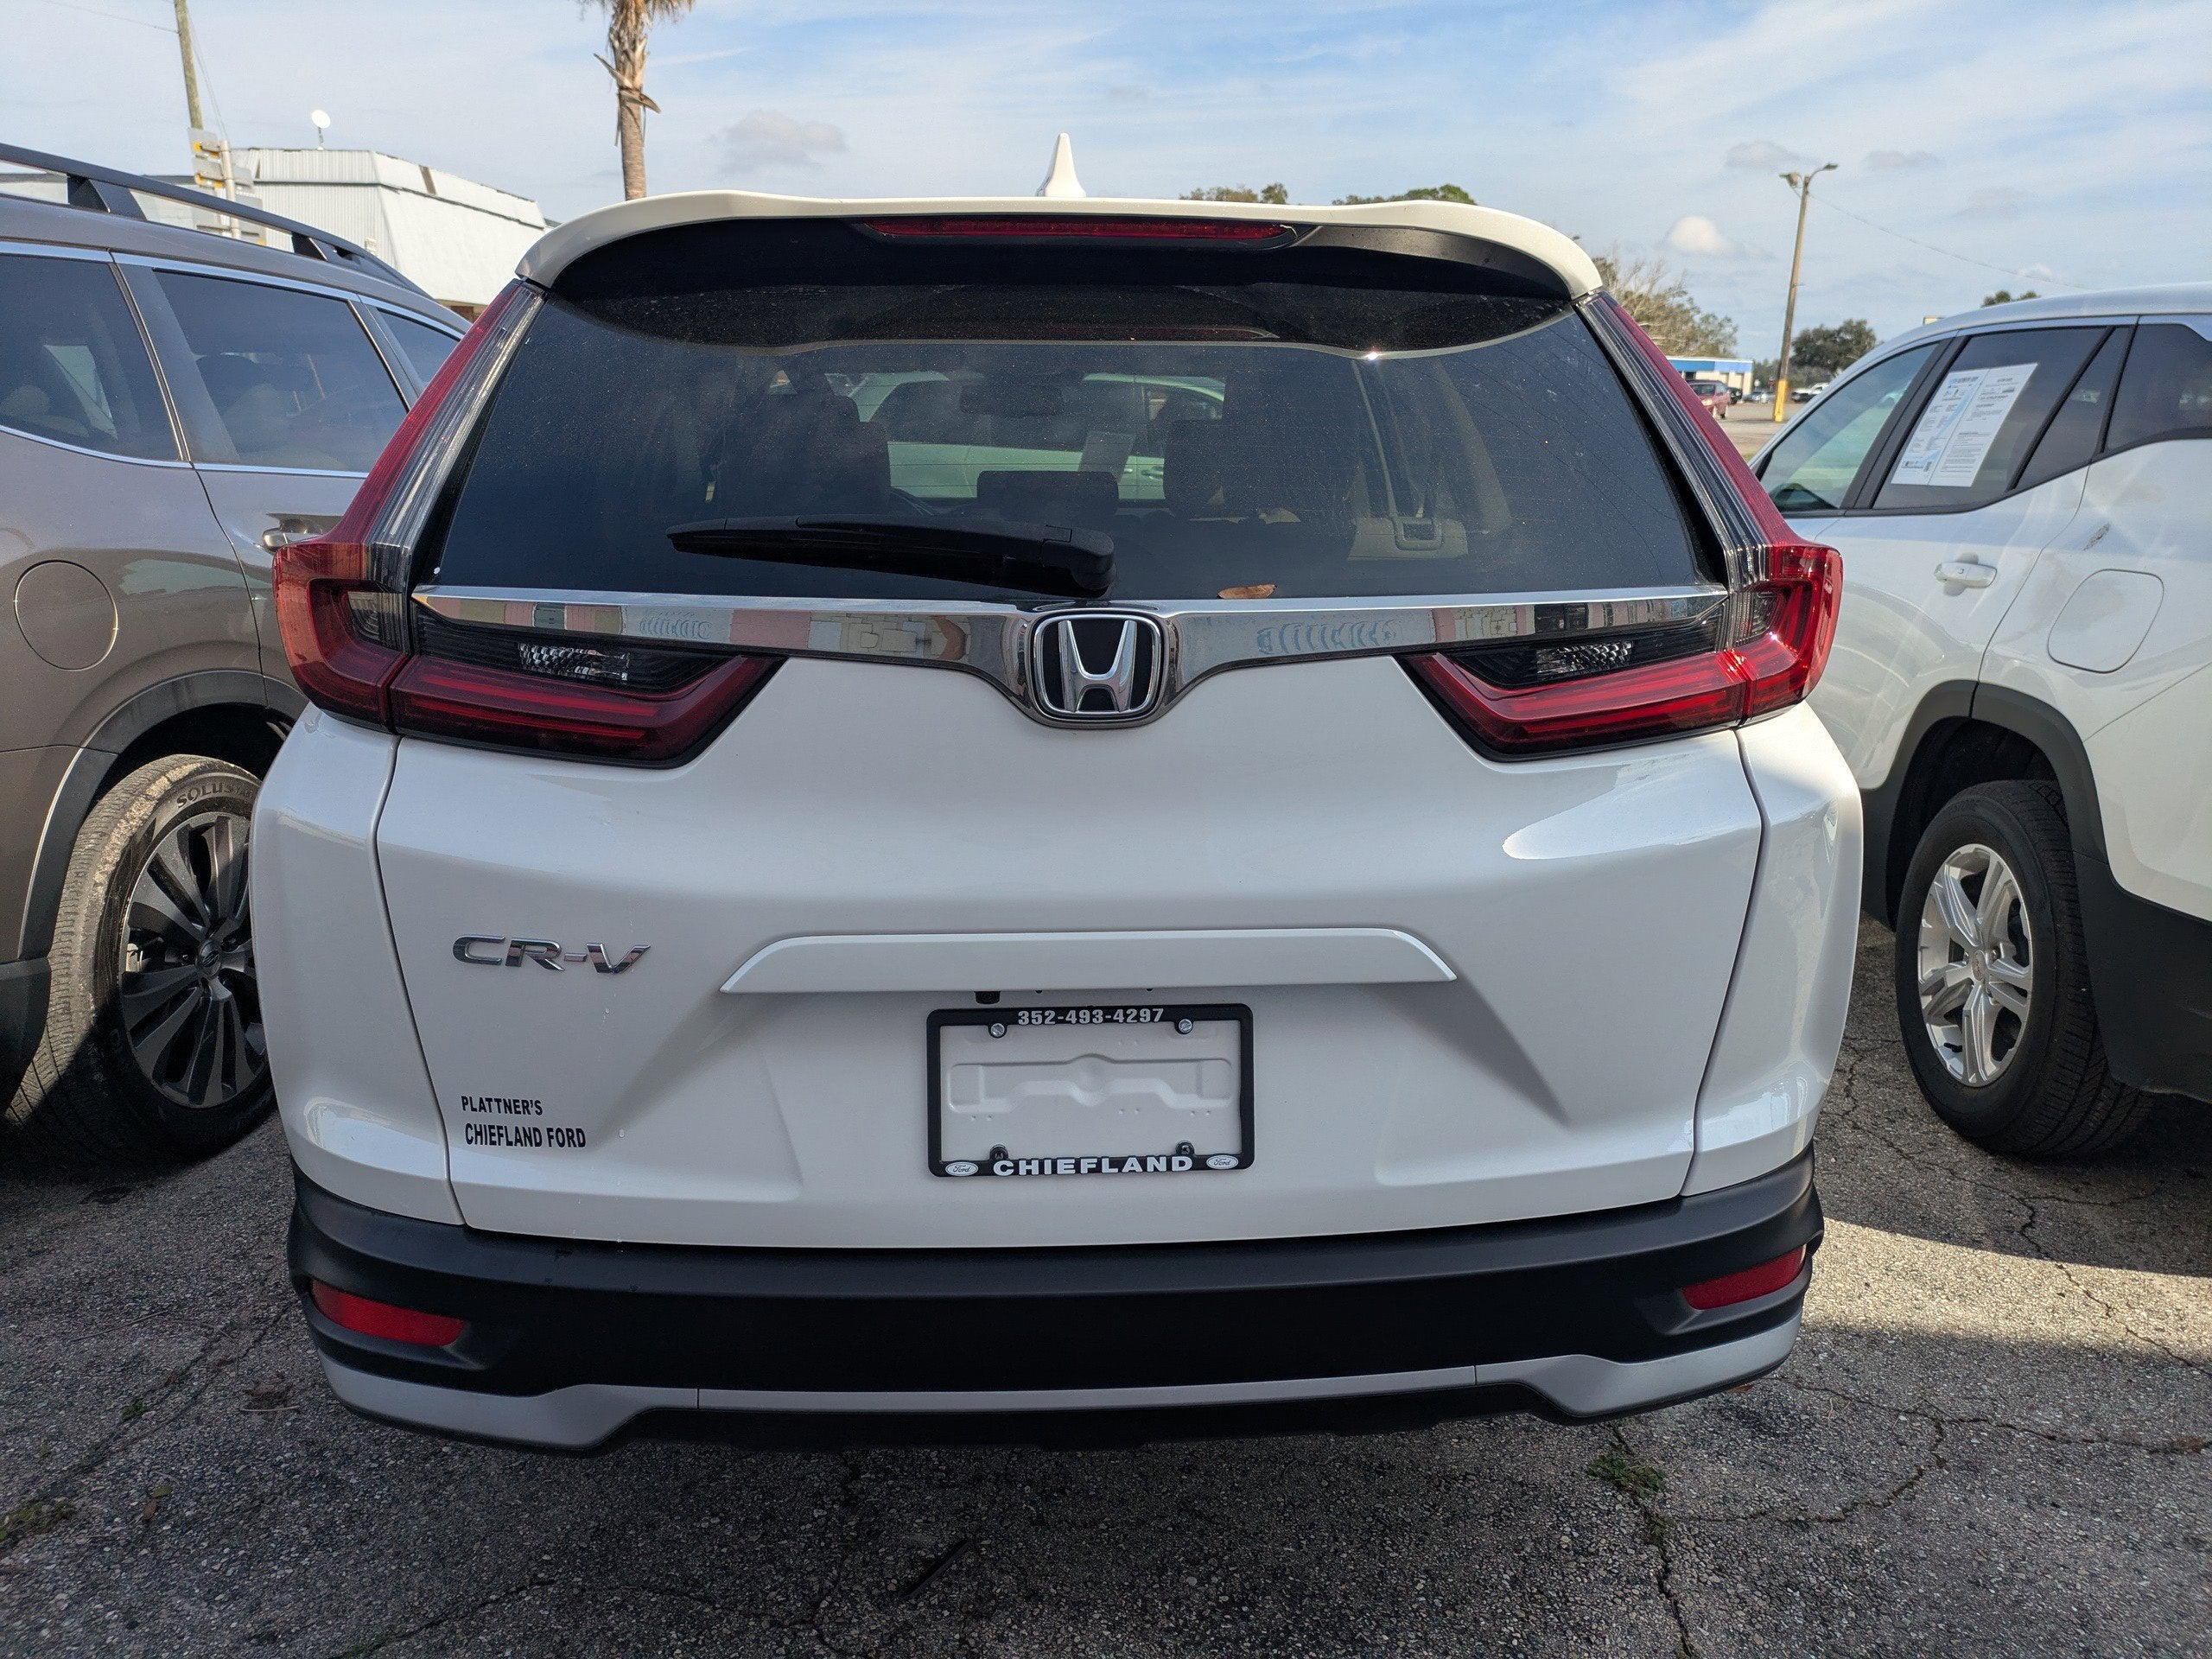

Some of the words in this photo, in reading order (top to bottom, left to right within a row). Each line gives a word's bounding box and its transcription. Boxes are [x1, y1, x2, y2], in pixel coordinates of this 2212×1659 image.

[452, 933, 652, 975] CR-V
[1017, 1008, 1165, 1026] 352-493-4297
[461, 1096, 543, 1116] PLATTNER'S
[465, 1122, 543, 1147] CHIEFLAND
[546, 1127, 587, 1147] FORD
[993, 1155, 1193, 1176] CHIEFLAND
